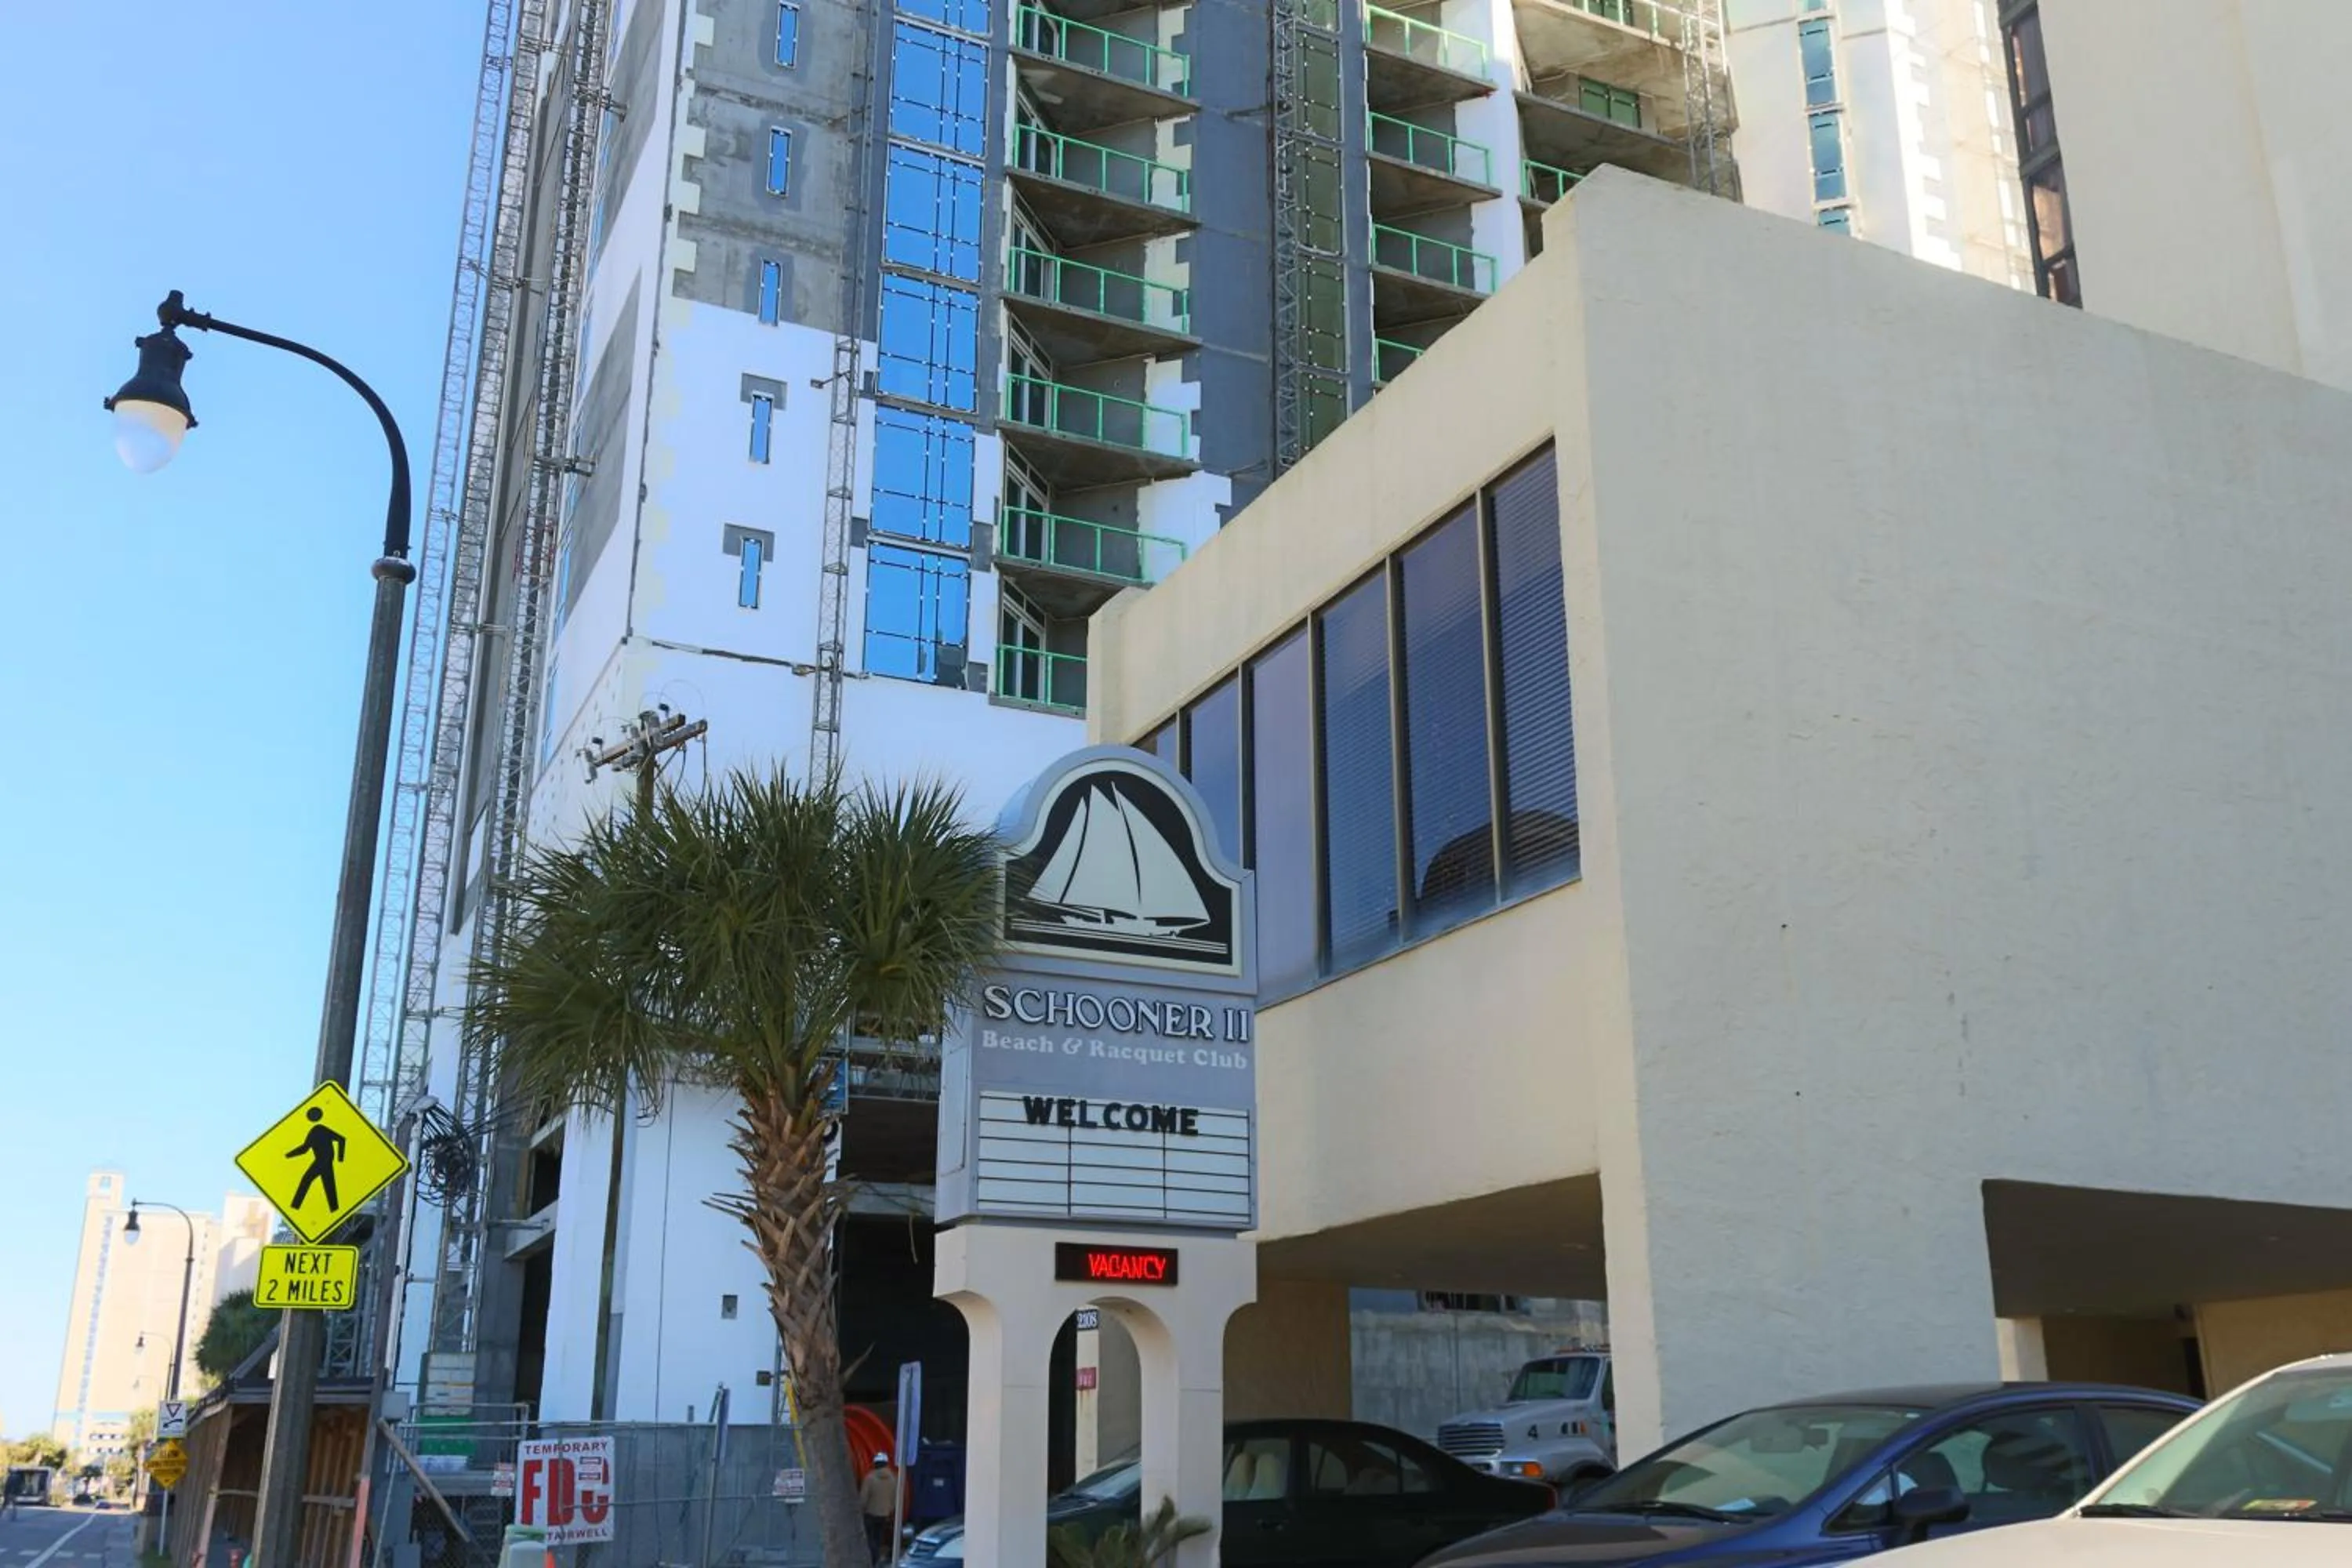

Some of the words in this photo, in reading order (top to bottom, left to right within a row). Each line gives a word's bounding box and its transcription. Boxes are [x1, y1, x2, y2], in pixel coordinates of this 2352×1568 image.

[984, 985, 1215, 1040] SCHOONER
[1224, 1007, 1250, 1042] II
[982, 1029, 1054, 1053] Beach
[1062, 1037, 1083, 1054] &
[1088, 1039, 1185, 1065] Racquet
[1193, 1049, 1248, 1069] Club
[1022, 1096, 1199, 1135] WELCOME
[285, 1252, 332, 1274] NEXT
[1087, 1253, 1167, 1279] VACANCY
[267, 1279, 279, 1301] 2
[287, 1279, 343, 1302] MILES
[524, 1442, 608, 1454] TEMPORARY
[546, 1527, 608, 1541] TAIRWELL
